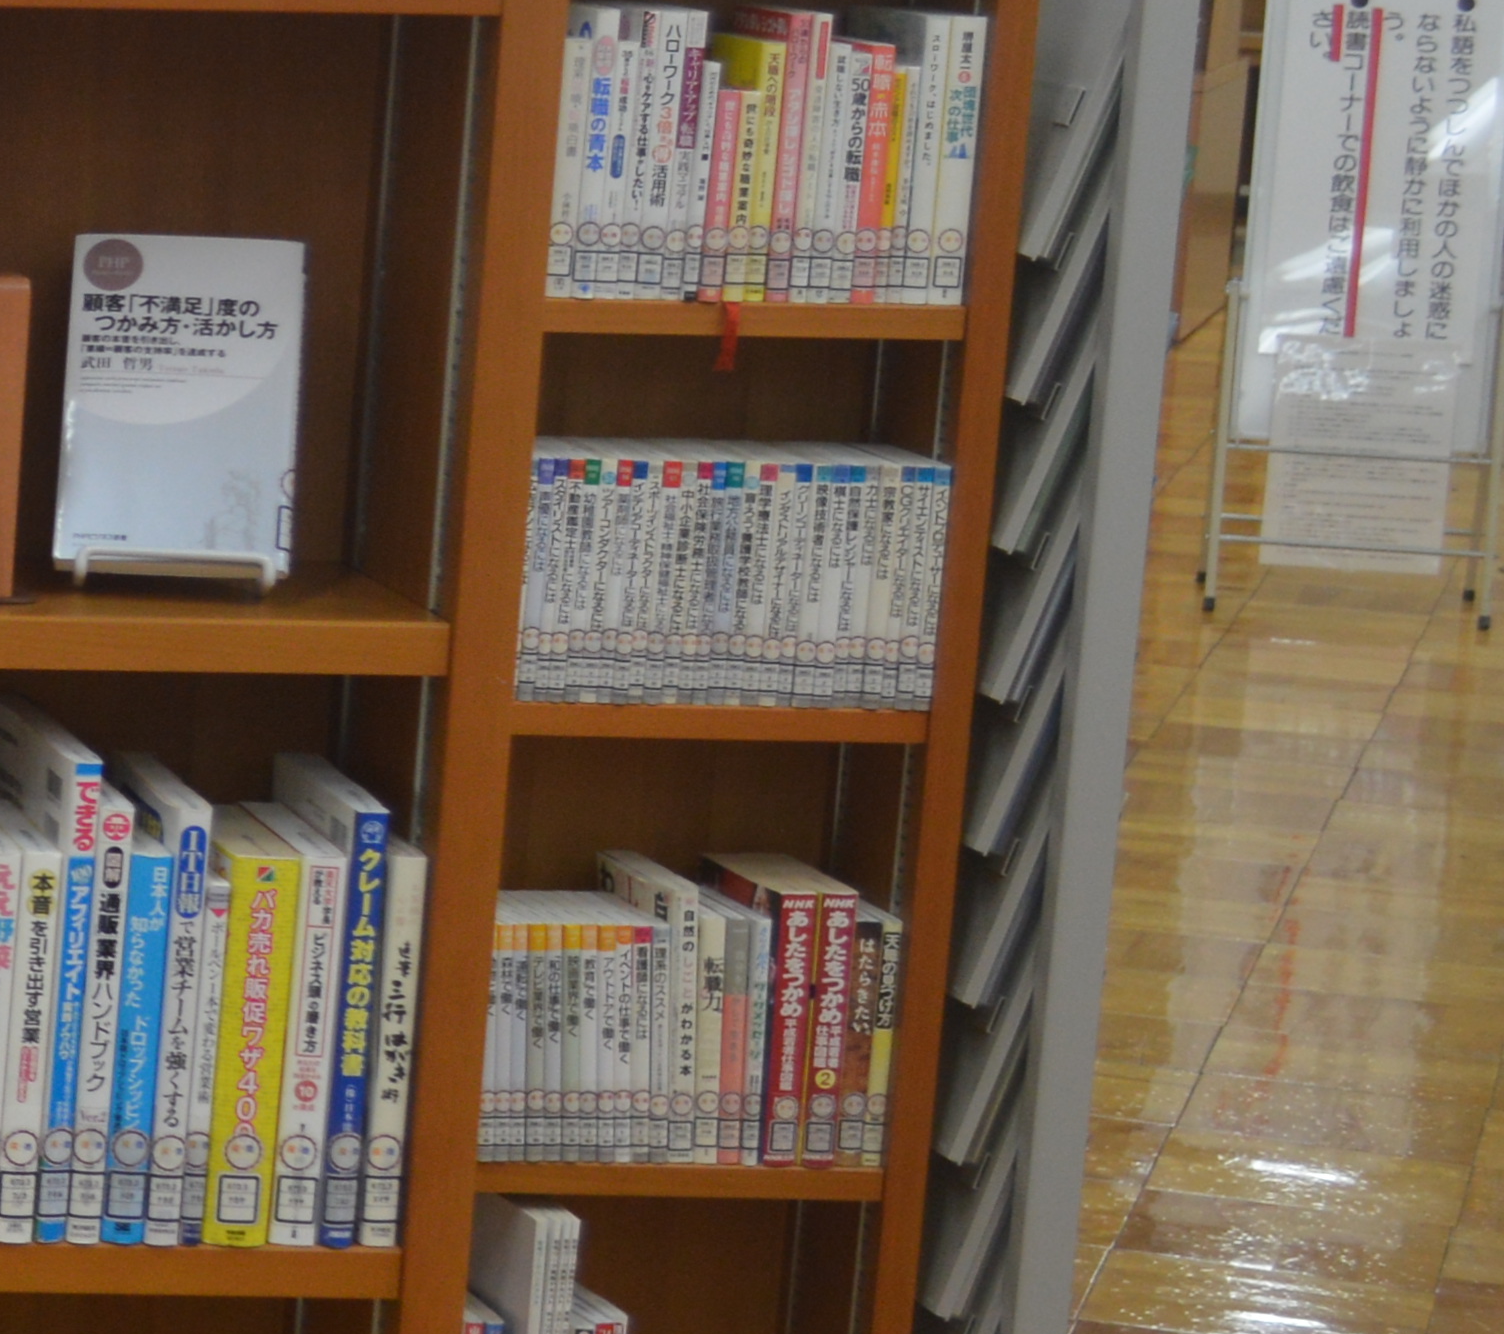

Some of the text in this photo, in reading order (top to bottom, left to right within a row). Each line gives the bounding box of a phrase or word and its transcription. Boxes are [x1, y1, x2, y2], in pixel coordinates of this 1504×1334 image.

[585, 77, 613, 172] 転職の青本
[843, 77, 871, 184] 50歳からの転職
[1391, 12, 1441, 339] ならないように静かに利用しましょ
[1424, 12, 1477, 340] 私語をつつしんでほかの人の迷惑に
[82, 292, 261, 318] 顧客「不満足」度の
[94, 314, 280, 341] つかみ方・活かし方
[342, 848, 383, 1077] クレーム対応の教科書
[777, 899, 815, 1018] NHK あしたをつかめ
